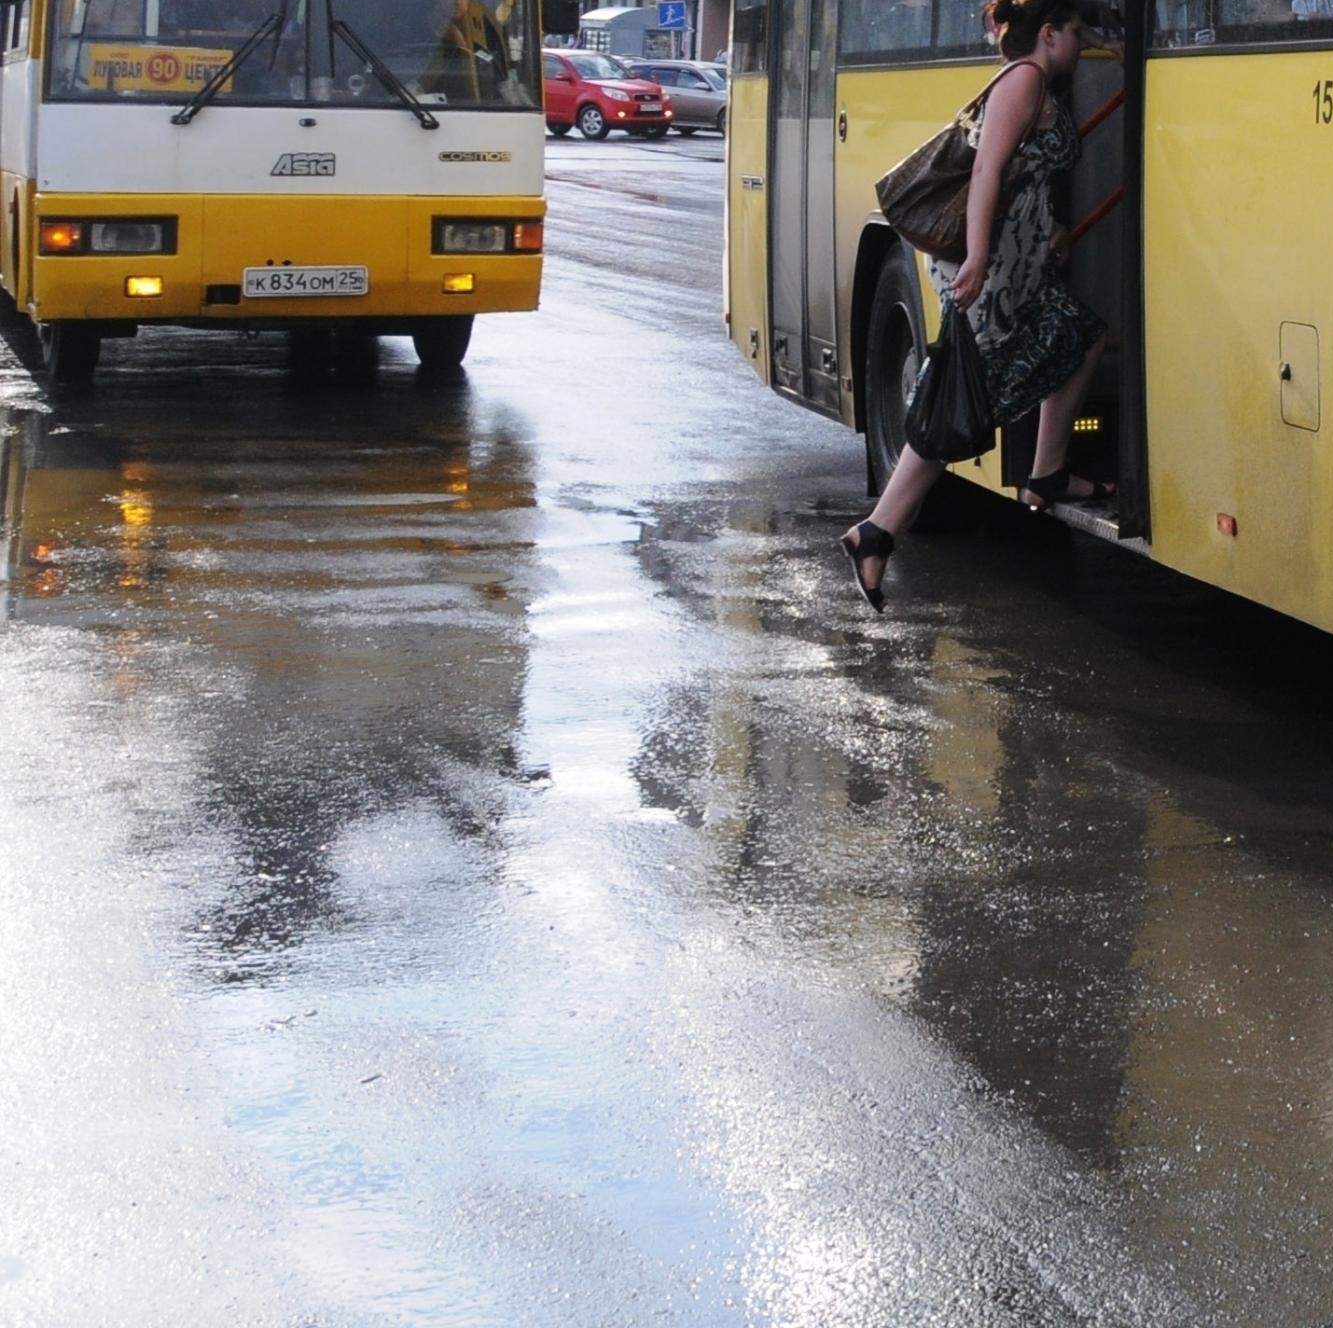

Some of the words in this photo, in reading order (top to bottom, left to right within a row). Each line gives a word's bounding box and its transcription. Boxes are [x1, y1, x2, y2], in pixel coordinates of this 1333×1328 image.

[152, 58, 176, 80] 90
[255, 277, 266, 290] К
[270, 273, 307, 290] 834
[310, 276, 334, 290] ОМ
[339, 271, 359, 285] 25
